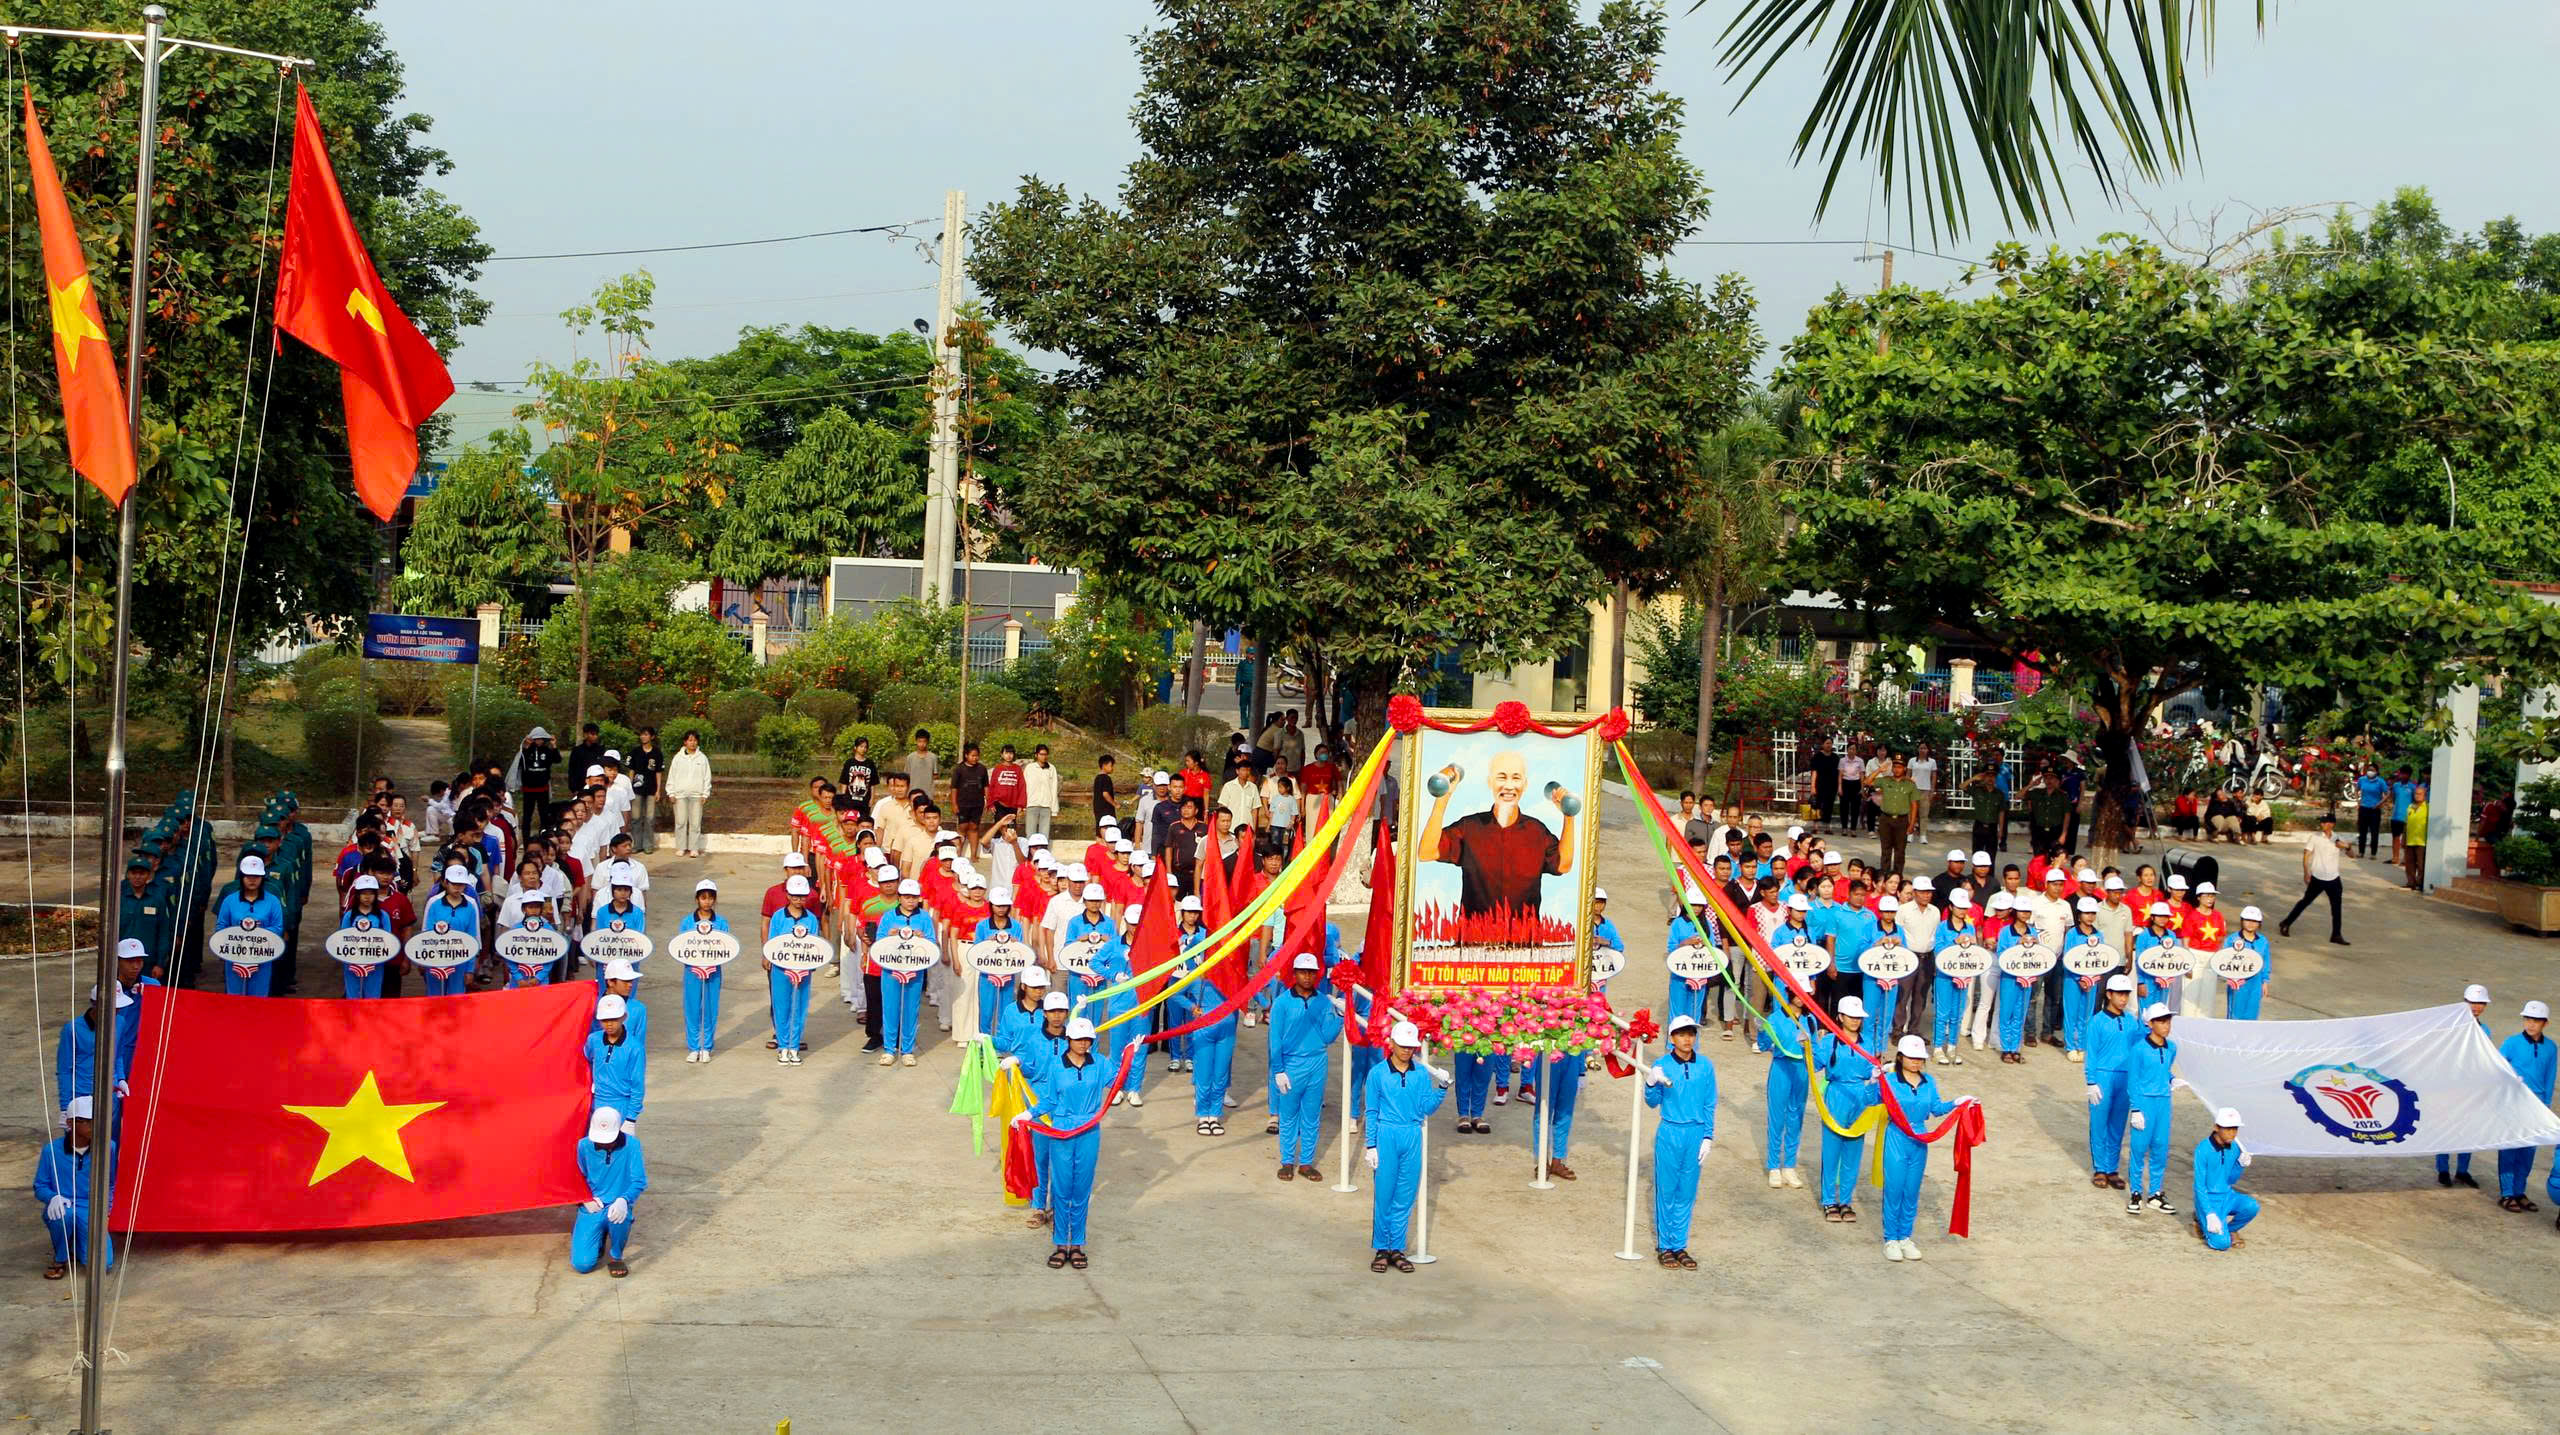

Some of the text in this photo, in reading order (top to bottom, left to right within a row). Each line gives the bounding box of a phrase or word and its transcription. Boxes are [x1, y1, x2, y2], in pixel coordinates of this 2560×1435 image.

[417, 636, 444, 646] THANH
[446, 637, 466, 648] NIÊN
[383, 647, 398, 656] CHI
[231, 944, 247, 956] LỘC
[505, 944, 523, 956] LỘC
[897, 941, 914, 950] ẤP
[993, 944, 1010, 954] ẤP
[336, 945, 389, 958] LỘC THIỆN
[415, 948, 469, 961] LỘC THỊNH
[590, 945, 600, 956] XÃ
[602, 945, 617, 958] LỘC
[678, 947, 730, 961] LỘC THỊNH
[772, 950, 790, 962] LỘC
[1691, 950, 1705, 959] ẤP
[1792, 949, 1807, 958] ẤP
[1882, 951, 1896, 960] ẤP
[1958, 950, 1972, 959] ẤP
[2021, 949, 2035, 958] ẤP
[2086, 948, 2100, 957] ẤP
[2160, 950, 2174, 959] ẤP
[2231, 952, 2245, 961] ẤP
[879, 953, 930, 966] HƯNG THỊNH
[1943, 959, 1958, 970] LỘC
[1979, 962, 1985, 970] 2
[2074, 960, 2081, 969] K
[1675, 960, 1688, 971] TÀ
[1815, 961, 1822, 969] 2
[1867, 961, 1881, 972] TÀ
[1904, 964, 1909, 972] 1
[2006, 960, 2021, 970] LỘC
[2044, 961, 2048, 969] 1
[1456, 964, 1486, 983] NGÀY
[1488, 964, 1510, 983] NÀO
[1512, 965, 1541, 983] CŨNG
[2352, 1120, 2382, 1129] 2026
